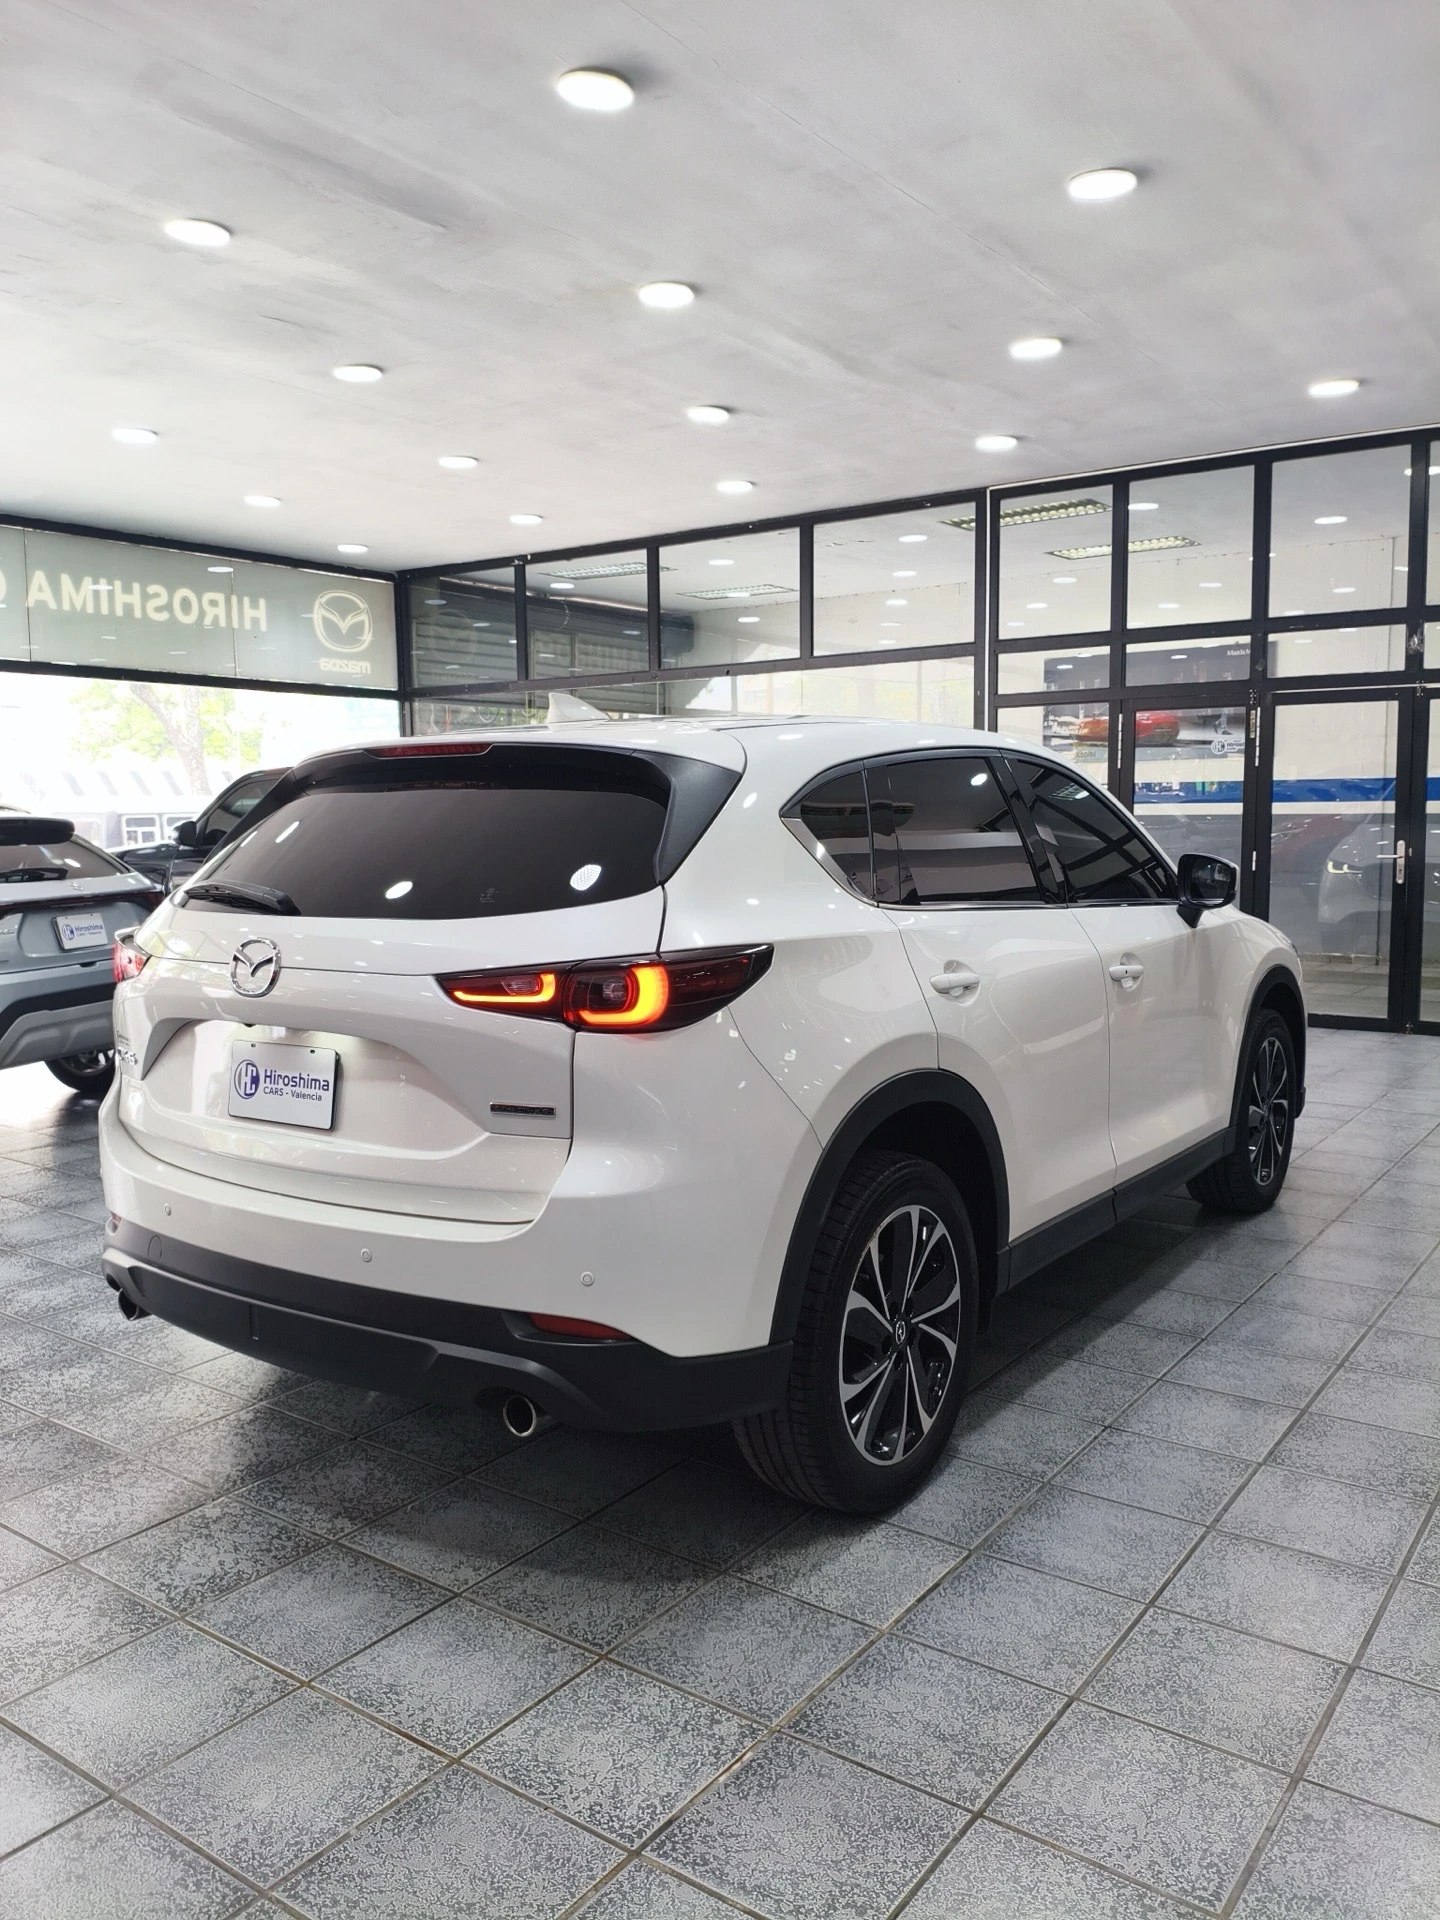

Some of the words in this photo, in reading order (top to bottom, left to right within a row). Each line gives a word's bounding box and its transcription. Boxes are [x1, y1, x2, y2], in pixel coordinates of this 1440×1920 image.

[263, 1068, 330, 1092] Hiroshima
[263, 1086, 284, 1097] CARS
[290, 1089, 323, 1102] Valencia
